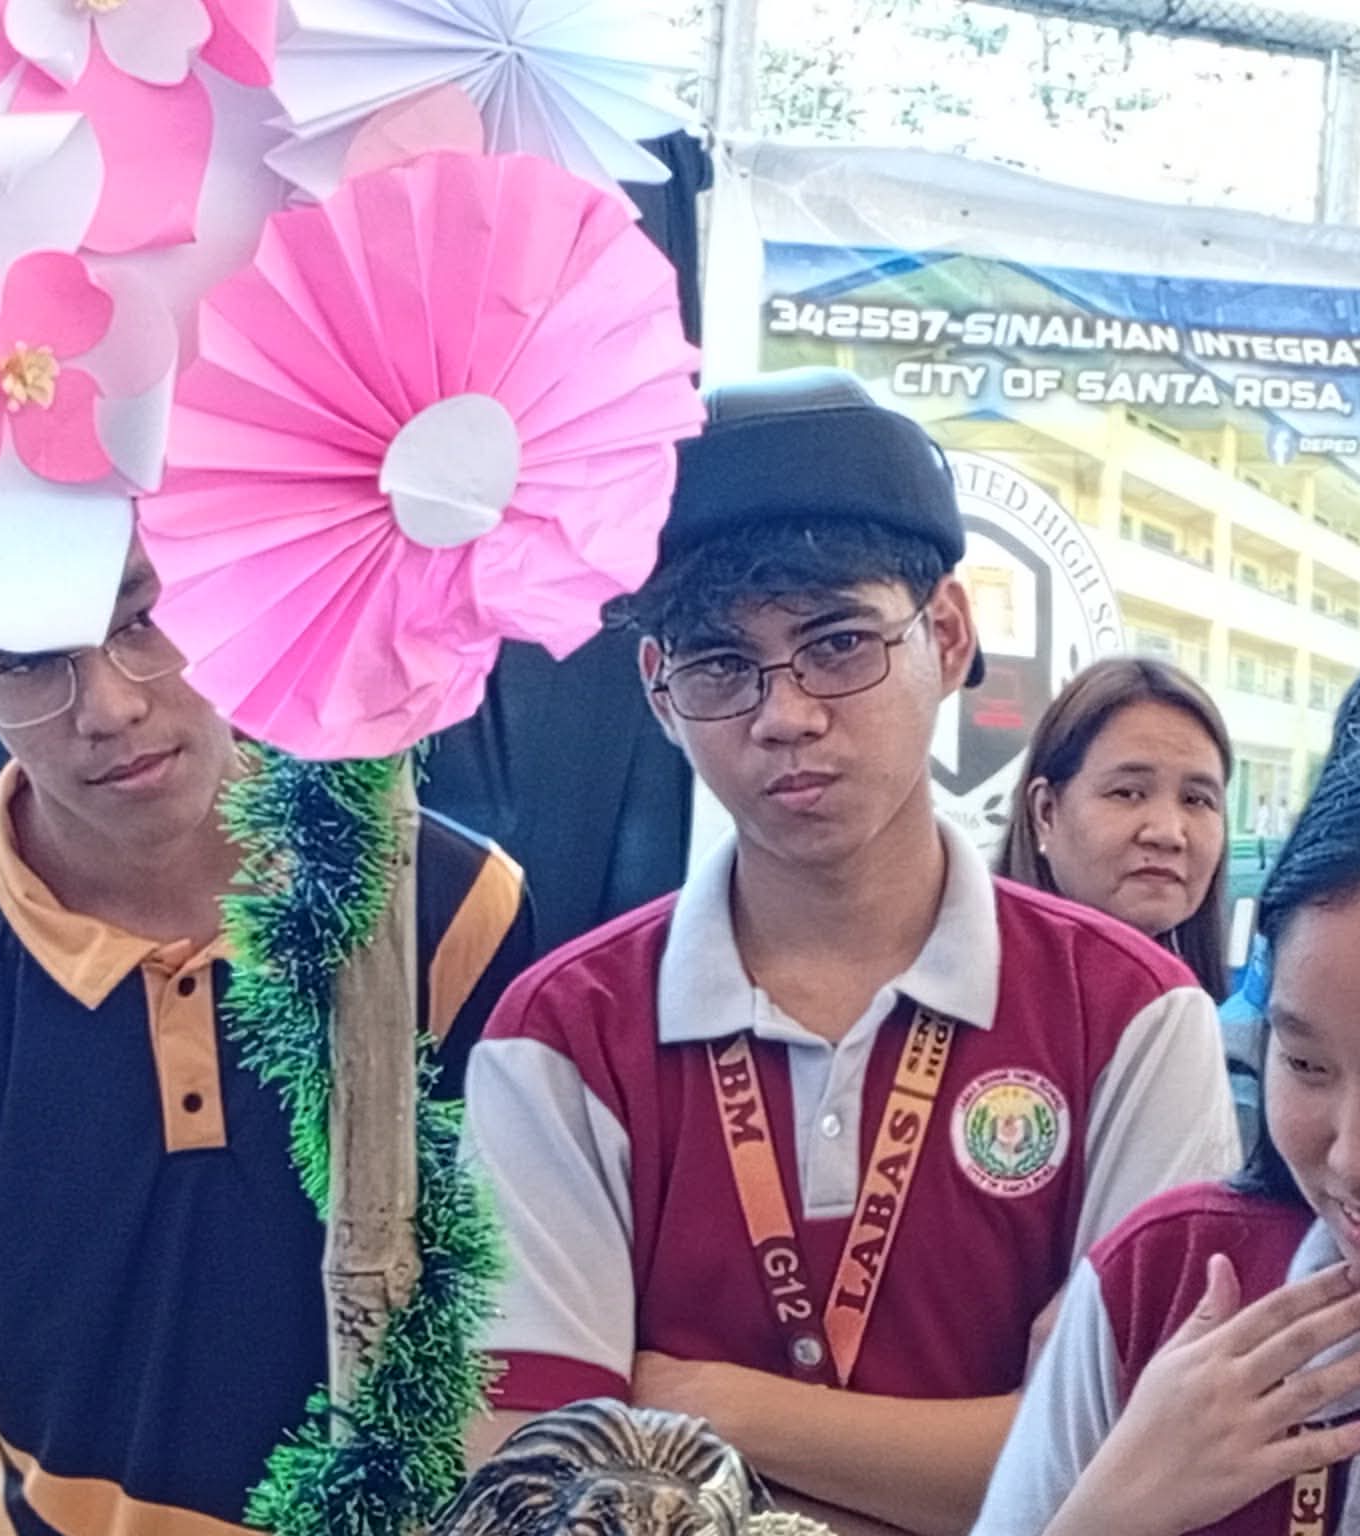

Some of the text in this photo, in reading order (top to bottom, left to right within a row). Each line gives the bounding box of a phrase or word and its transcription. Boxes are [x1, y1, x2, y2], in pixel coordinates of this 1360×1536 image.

[769, 300, 1181, 353] 342597-SINALHAN
[893, 361, 986, 397] CITY
[1003, 367, 1062, 398] OF
[1077, 371, 1220, 405] SANTA
[1234, 378, 1353, 416] ROSA,
[1033, 503, 1100, 594] HIGH
[835, 1106, 921, 1315] LABAS
[763, 1249, 813, 1324] G12
